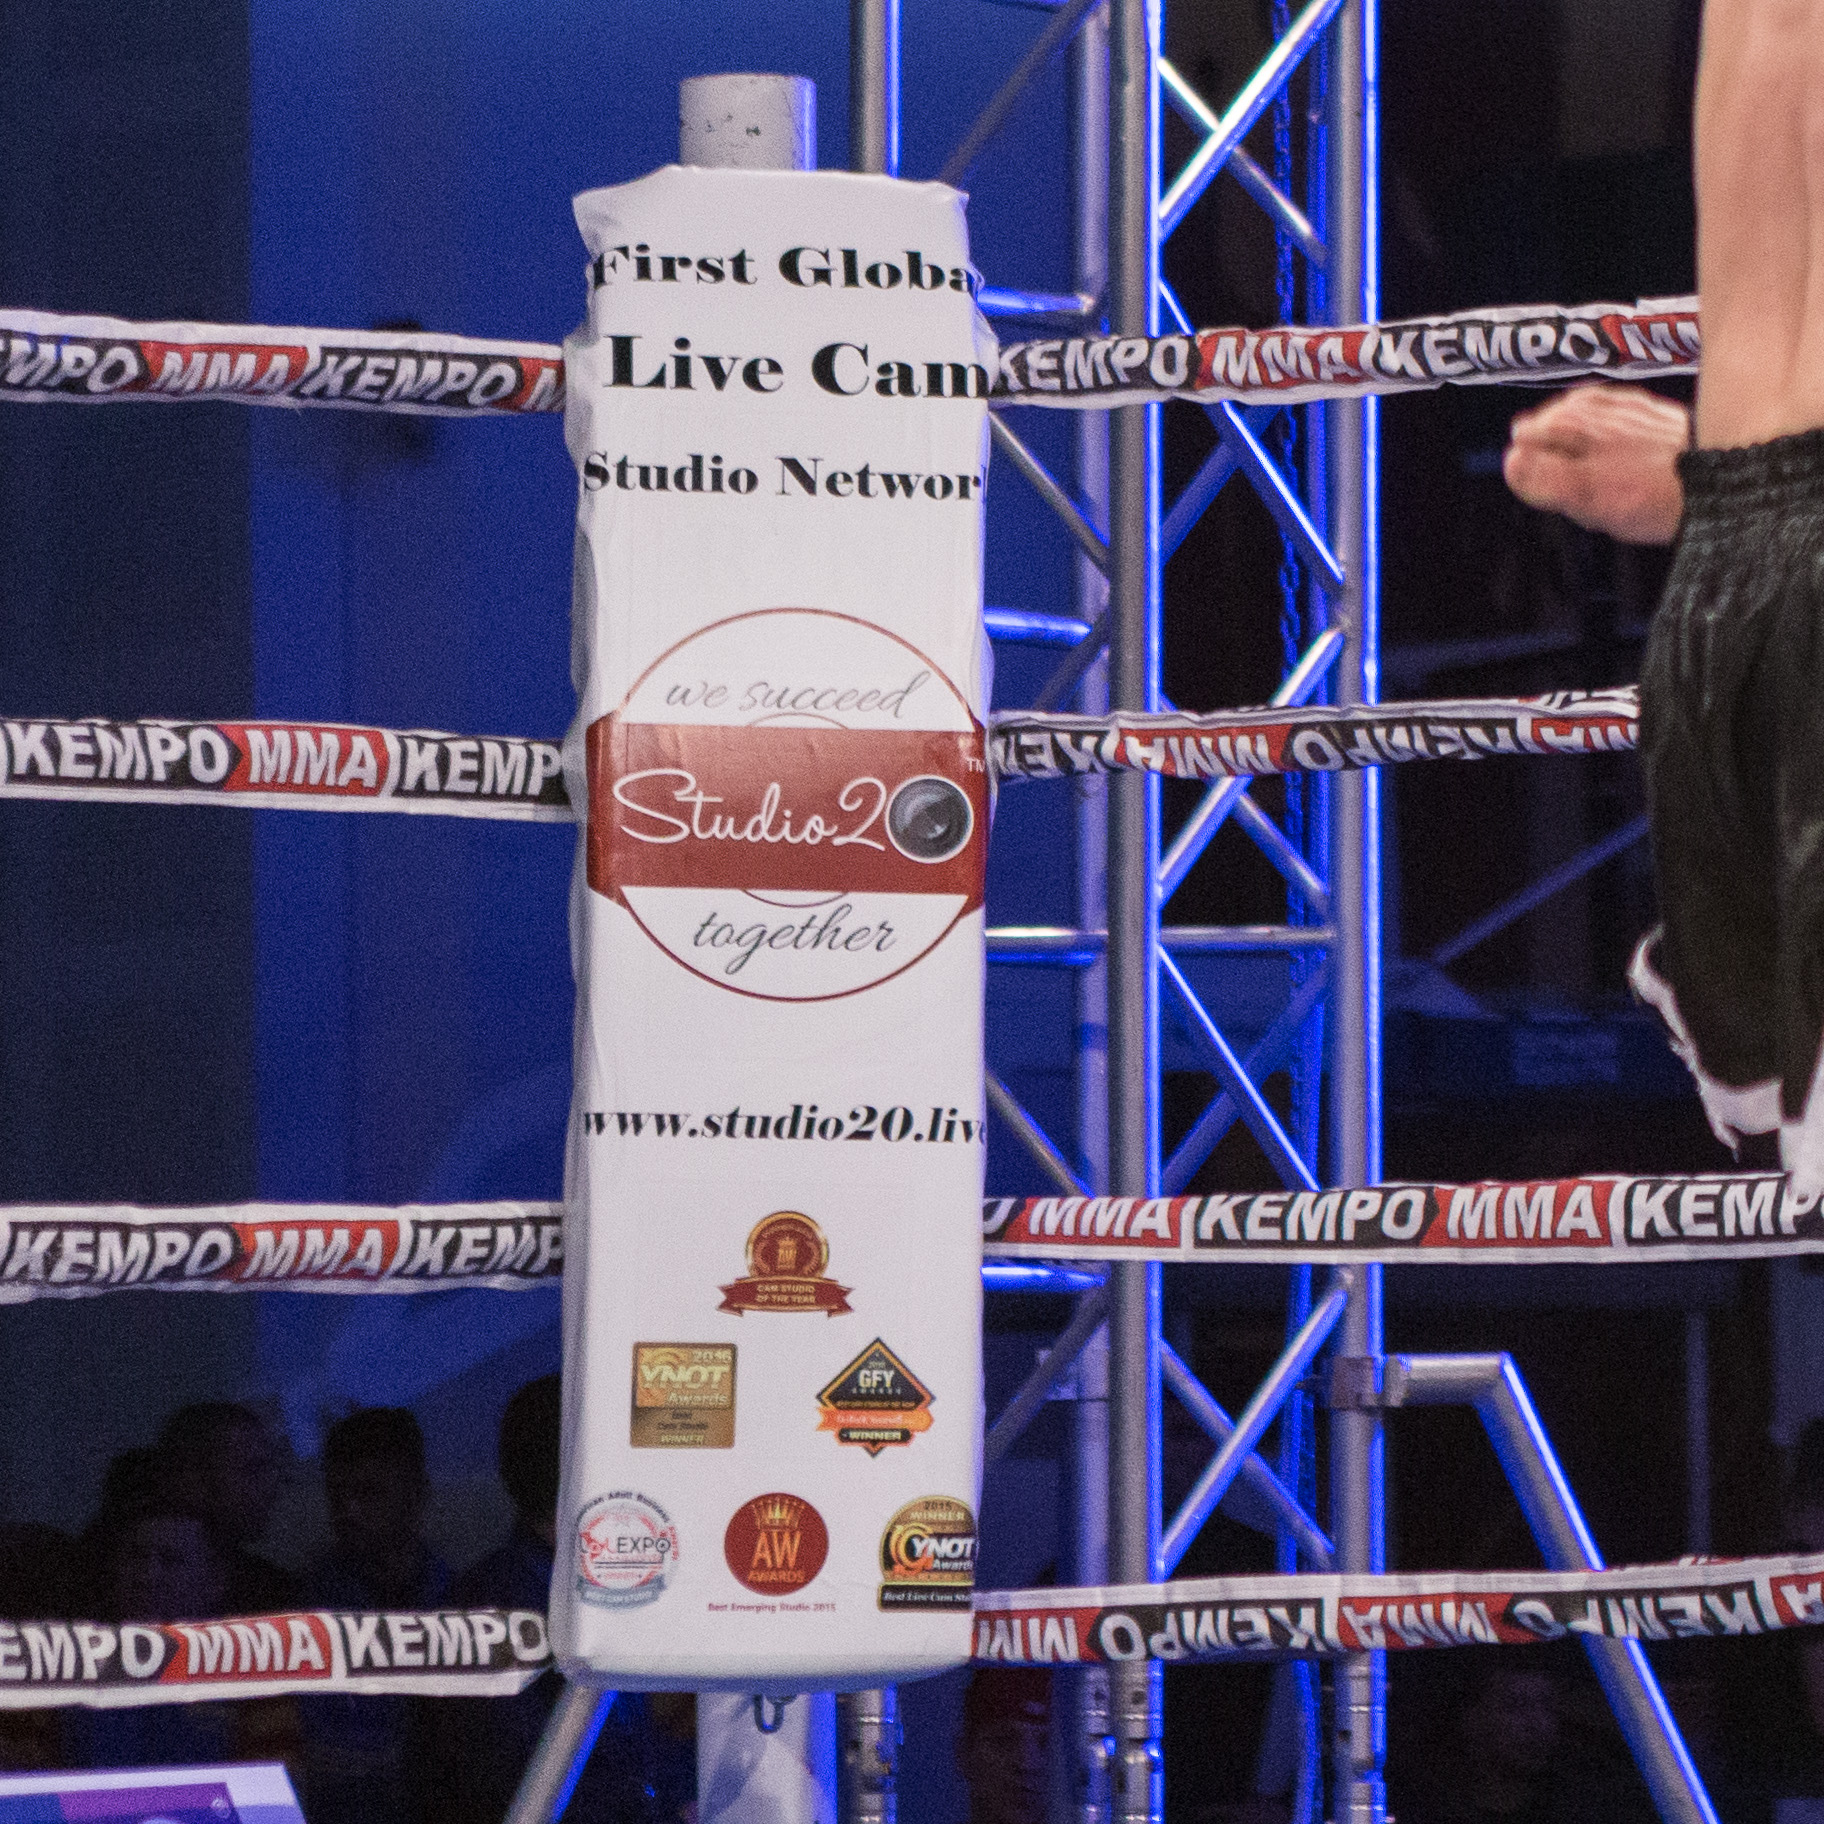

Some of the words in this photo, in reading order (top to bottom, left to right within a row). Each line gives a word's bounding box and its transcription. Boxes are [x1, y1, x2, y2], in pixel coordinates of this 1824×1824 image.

[592, 244, 757, 289] First
[778, 247, 976, 292] Globa
[149, 350, 298, 394] MMA
[305, 350, 518, 407] KEMPO
[603, 334, 784, 392] Live
[811, 342, 990, 399] Cam
[998, 337, 1188, 392] KEMPO
[1211, 332, 1346, 382] MMA
[1379, 320, 1609, 377] KEMPO
[583, 450, 758, 495] Studio
[775, 456, 985, 501] Networ
[666, 680, 728, 710] we
[739, 670, 932, 719] succeed
[12, 721, 231, 784] KEMPO
[246, 728, 380, 790] MMA
[402, 738, 564, 797] KEMP
[692, 903, 897, 975] together
[1028, 1197, 1173, 1239] MMA
[1197, 1188, 1427, 1242] KEMPO
[1446, 1184, 1603, 1239] MMA
[4, 1227, 235, 1281] KEMPO
[246, 1227, 386, 1277] MMA
[408, 1226, 564, 1276] KEMP
[641, 1364, 730, 1389] YNOT
[858, 1369, 895, 1388] GFY
[751, 1530, 802, 1569] AW
[911, 1537, 976, 1558] YNOT
[0, 1621, 167, 1681] EMPO
[183, 1620, 326, 1675] MMA
[344, 1611, 550, 1669] KEMPO
[1099, 1608, 1329, 1662] KEMPO
